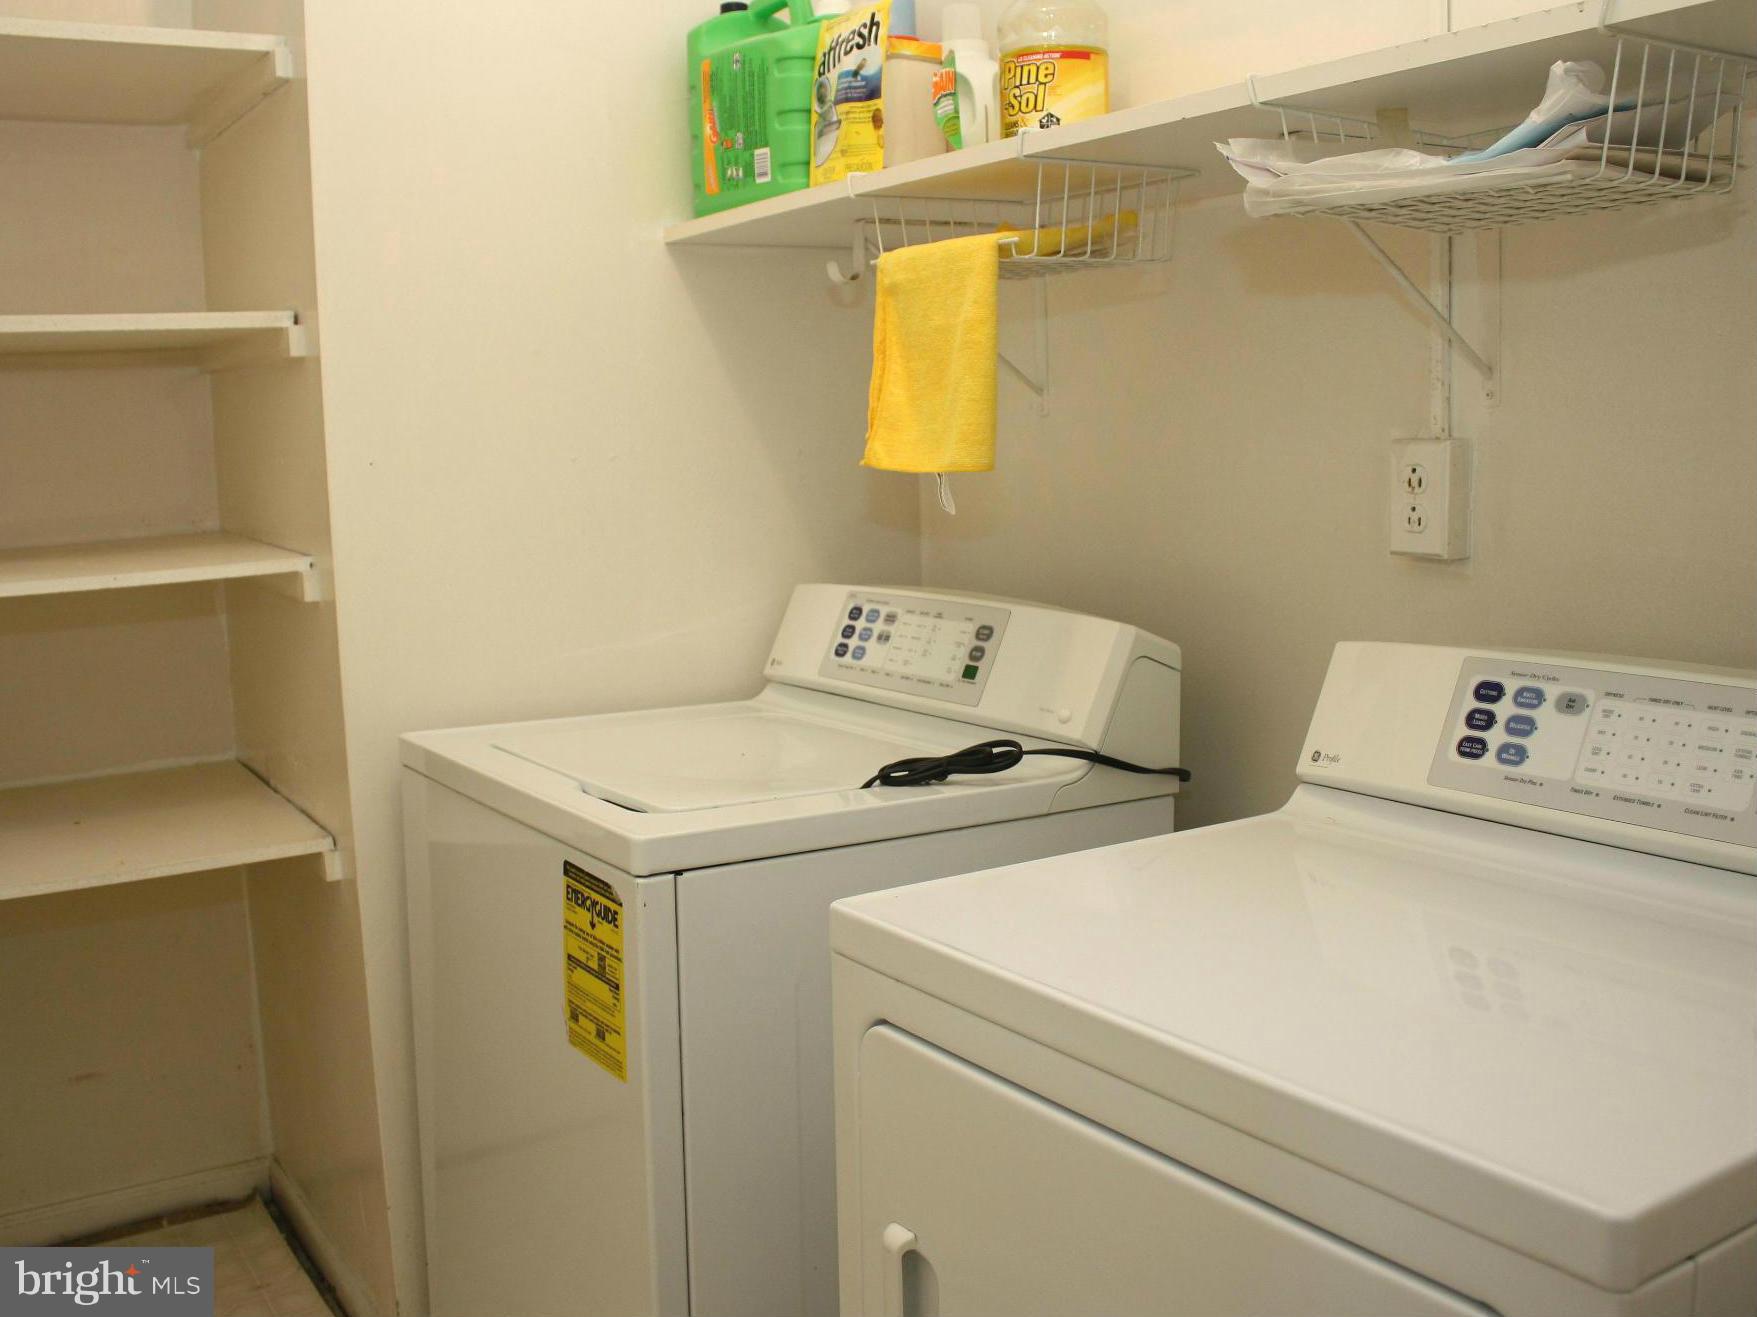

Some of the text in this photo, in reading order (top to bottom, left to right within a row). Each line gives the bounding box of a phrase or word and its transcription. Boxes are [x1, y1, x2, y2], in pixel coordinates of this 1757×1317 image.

[817, 12, 881, 77] affresh
[1003, 60, 1056, 91] Pine
[1007, 83, 1047, 117] Sol
